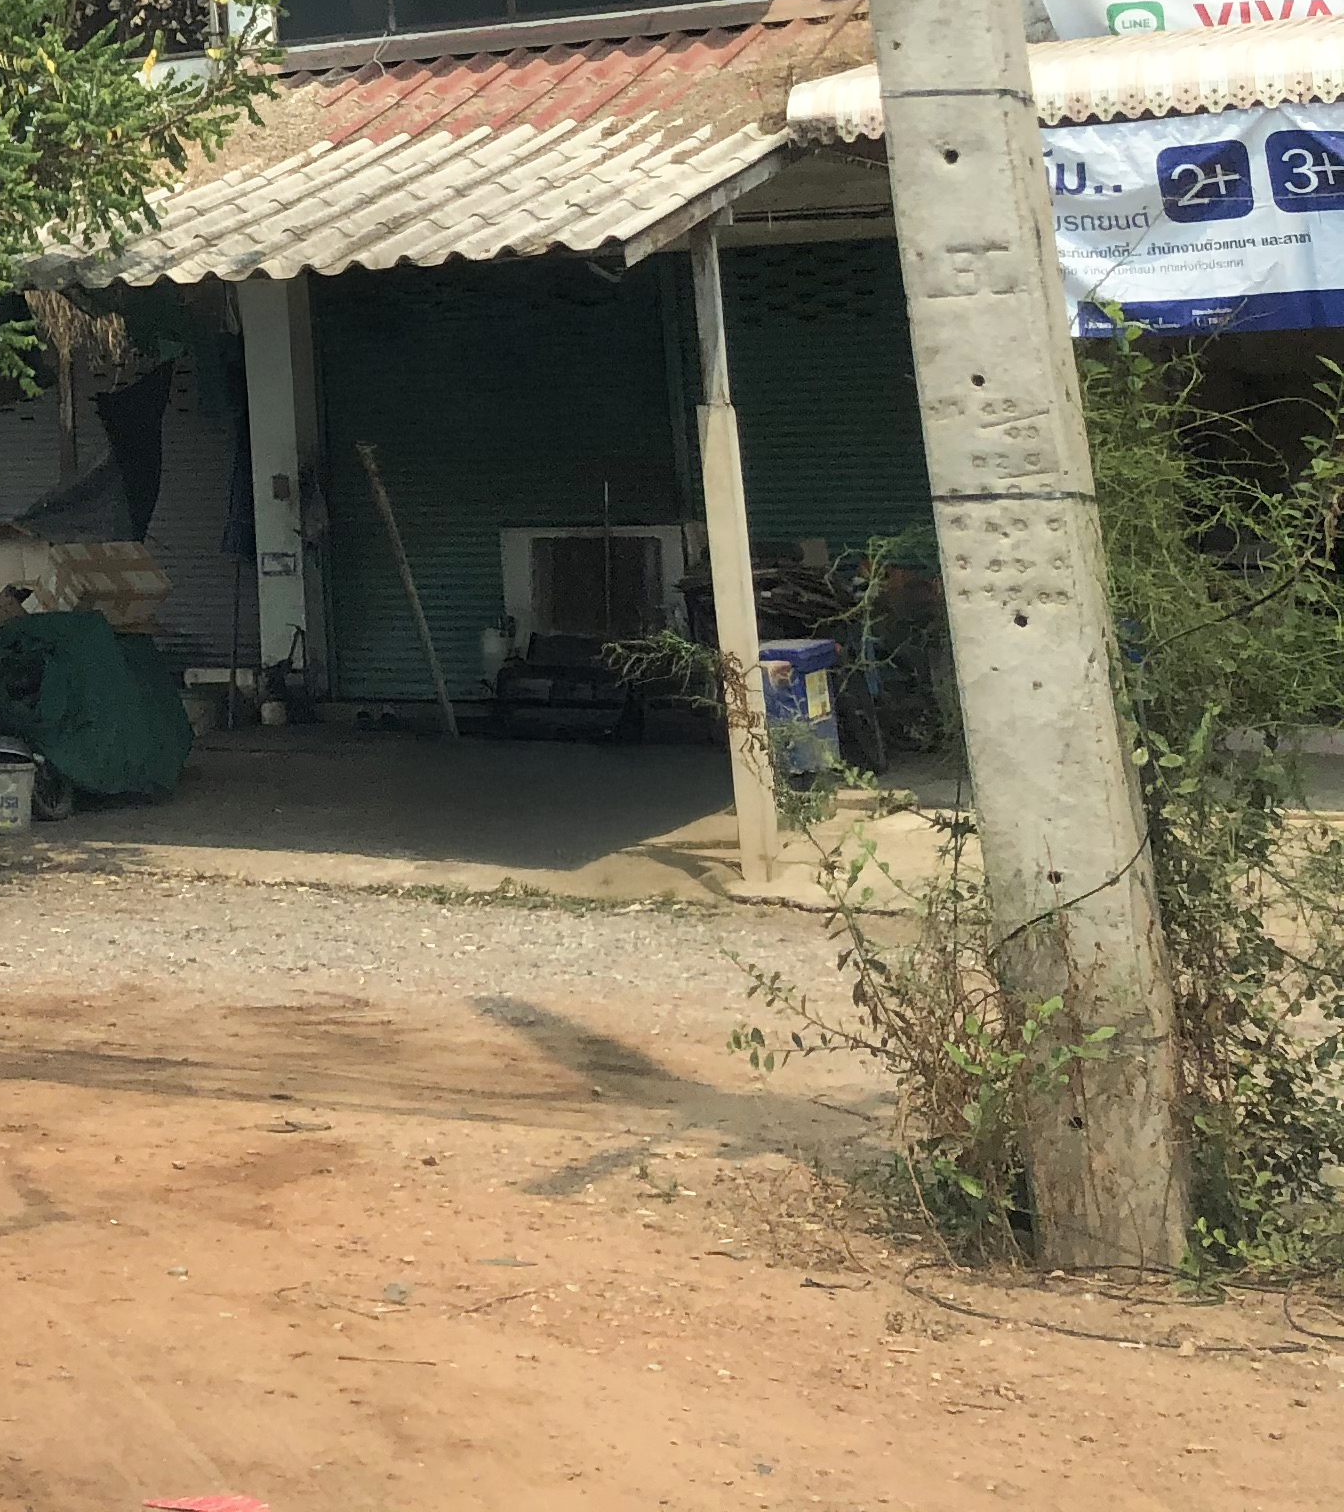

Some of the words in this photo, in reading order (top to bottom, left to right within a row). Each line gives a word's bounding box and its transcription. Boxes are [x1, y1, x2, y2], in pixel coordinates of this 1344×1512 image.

[1121, 18, 1152, 30] LINE
[1171, 164, 1242, 206] 2+
[1282, 148, 1344, 194] 3+
